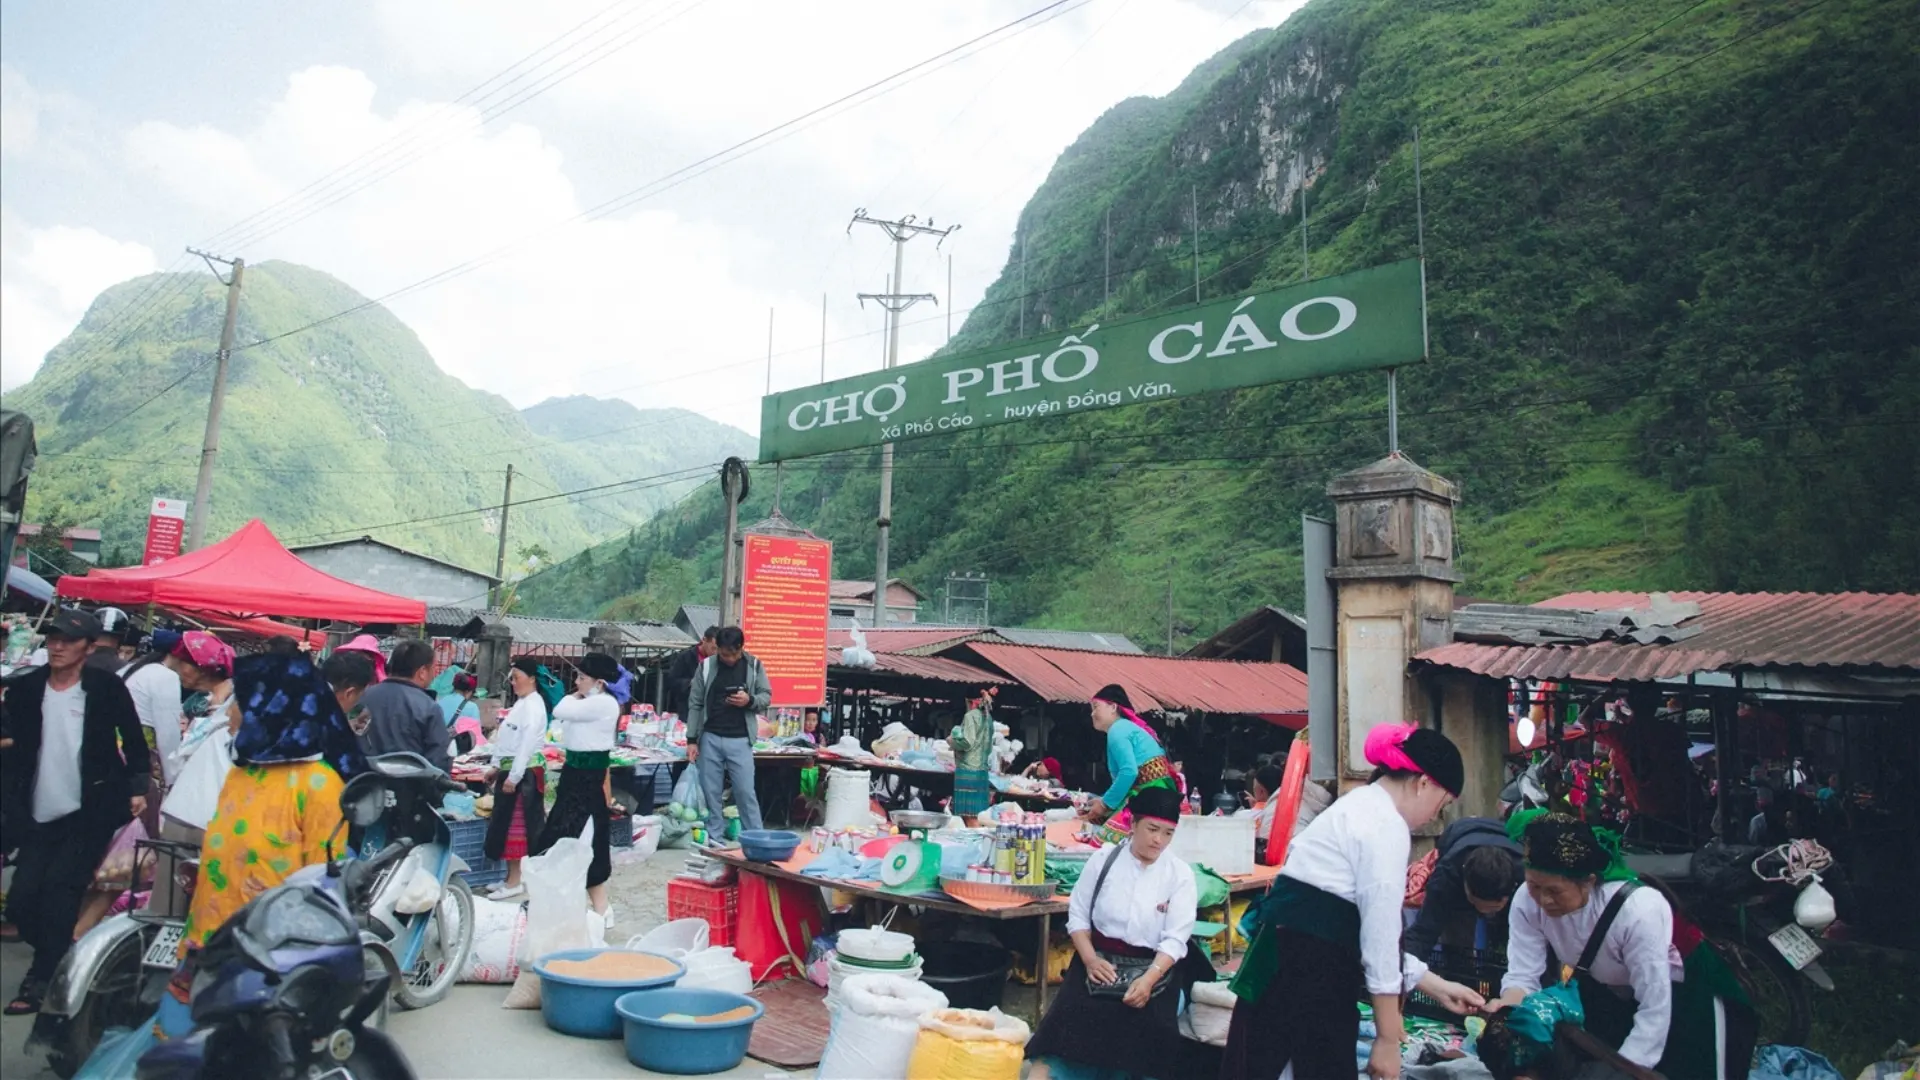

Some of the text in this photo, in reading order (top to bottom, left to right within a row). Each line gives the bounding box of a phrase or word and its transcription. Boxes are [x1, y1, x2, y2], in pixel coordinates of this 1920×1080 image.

[787, 296, 1358, 432] CHỢ PHỐ CÁO
[905, 415, 934, 435] Phố
[938, 412, 974, 429] Cáo
[1004, 399, 1061, 419] huyện
[1066, 388, 1122, 406] Đồng
